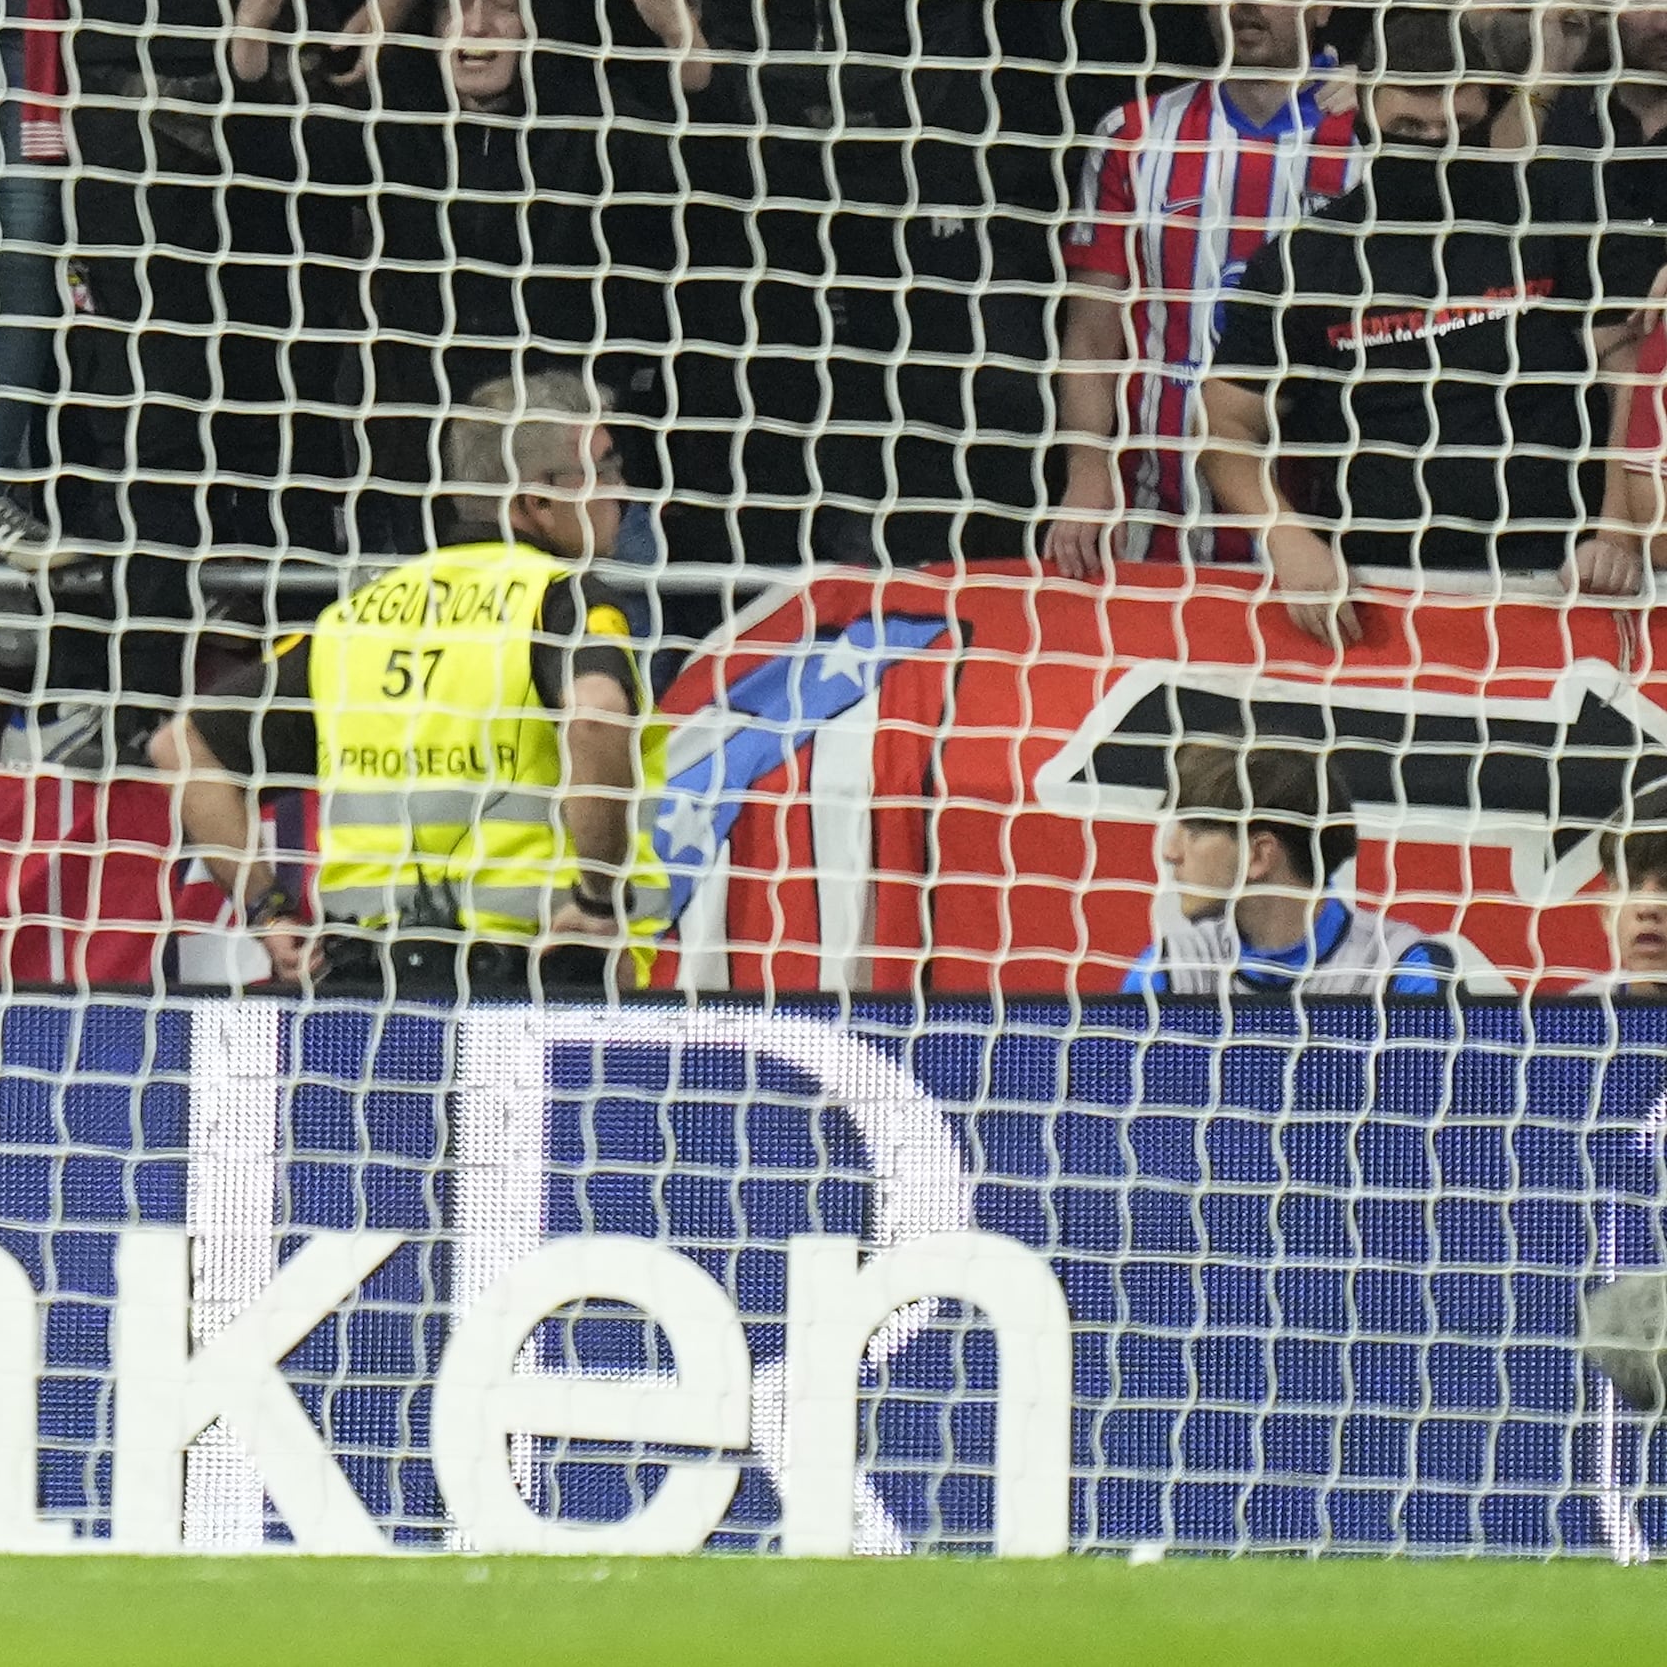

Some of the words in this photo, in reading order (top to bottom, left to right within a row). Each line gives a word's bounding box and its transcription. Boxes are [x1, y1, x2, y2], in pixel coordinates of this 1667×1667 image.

[336, 577, 528, 626] SEGURIDAD
[381, 648, 446, 699] 57
[341, 744, 517, 782] PROSEGUR
